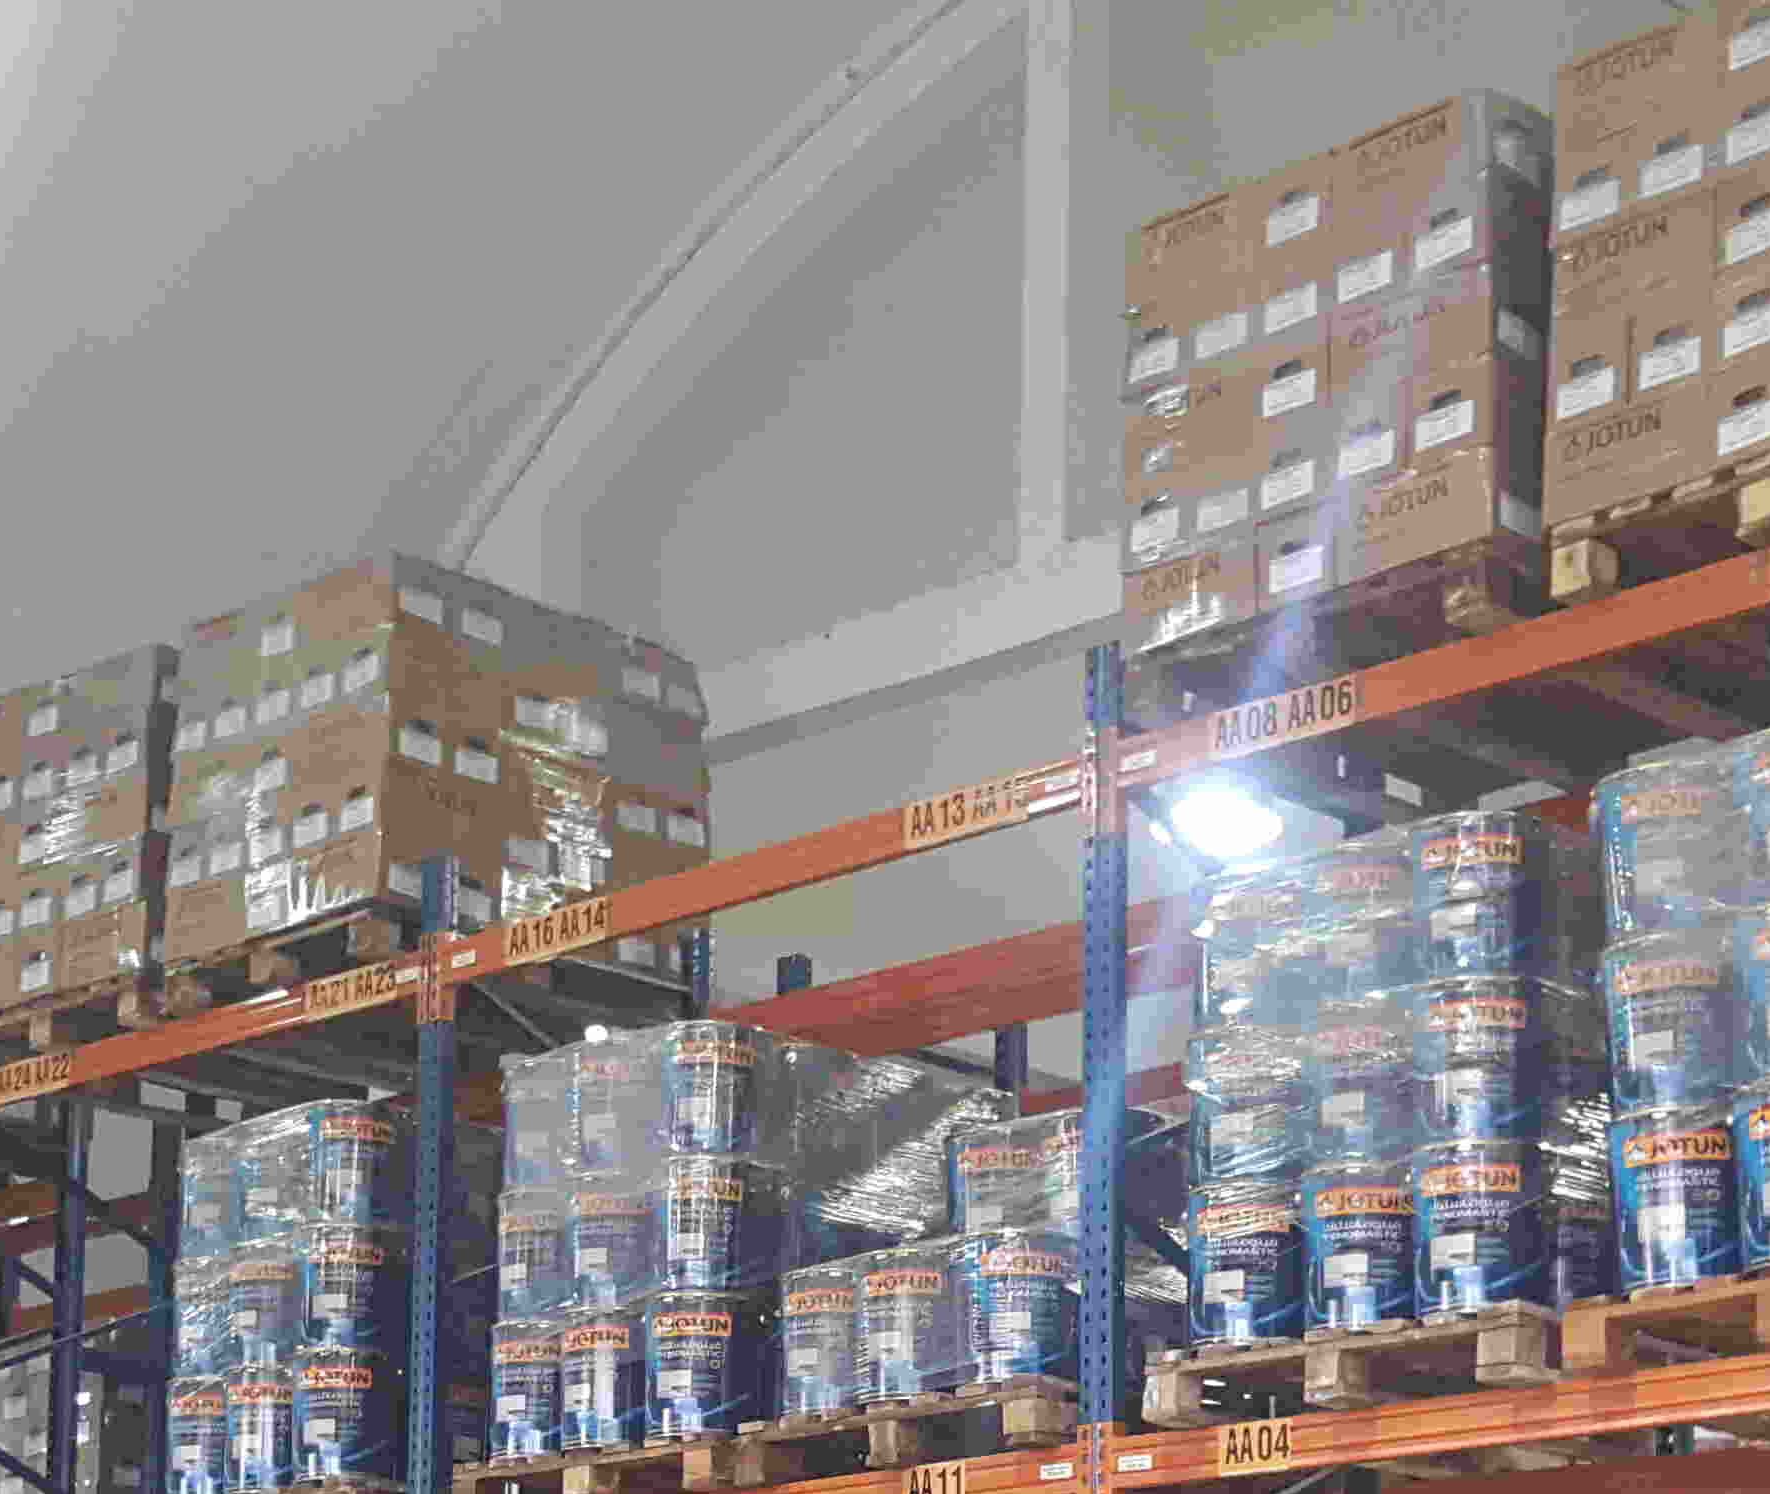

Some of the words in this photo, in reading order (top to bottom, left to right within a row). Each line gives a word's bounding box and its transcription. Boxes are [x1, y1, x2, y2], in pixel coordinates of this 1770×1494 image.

[1586, 409, 1661, 456] JOTUN
[1214, 700, 1276, 751] AA08
[1288, 680, 1350, 733] AA06
[910, 797, 965, 838] AA13
[509, 918, 555, 958] AA16
[560, 899, 605, 940] AA14
[1651, 1131, 1727, 1162] JOTUN
[1225, 1423, 1289, 1465] AA04
